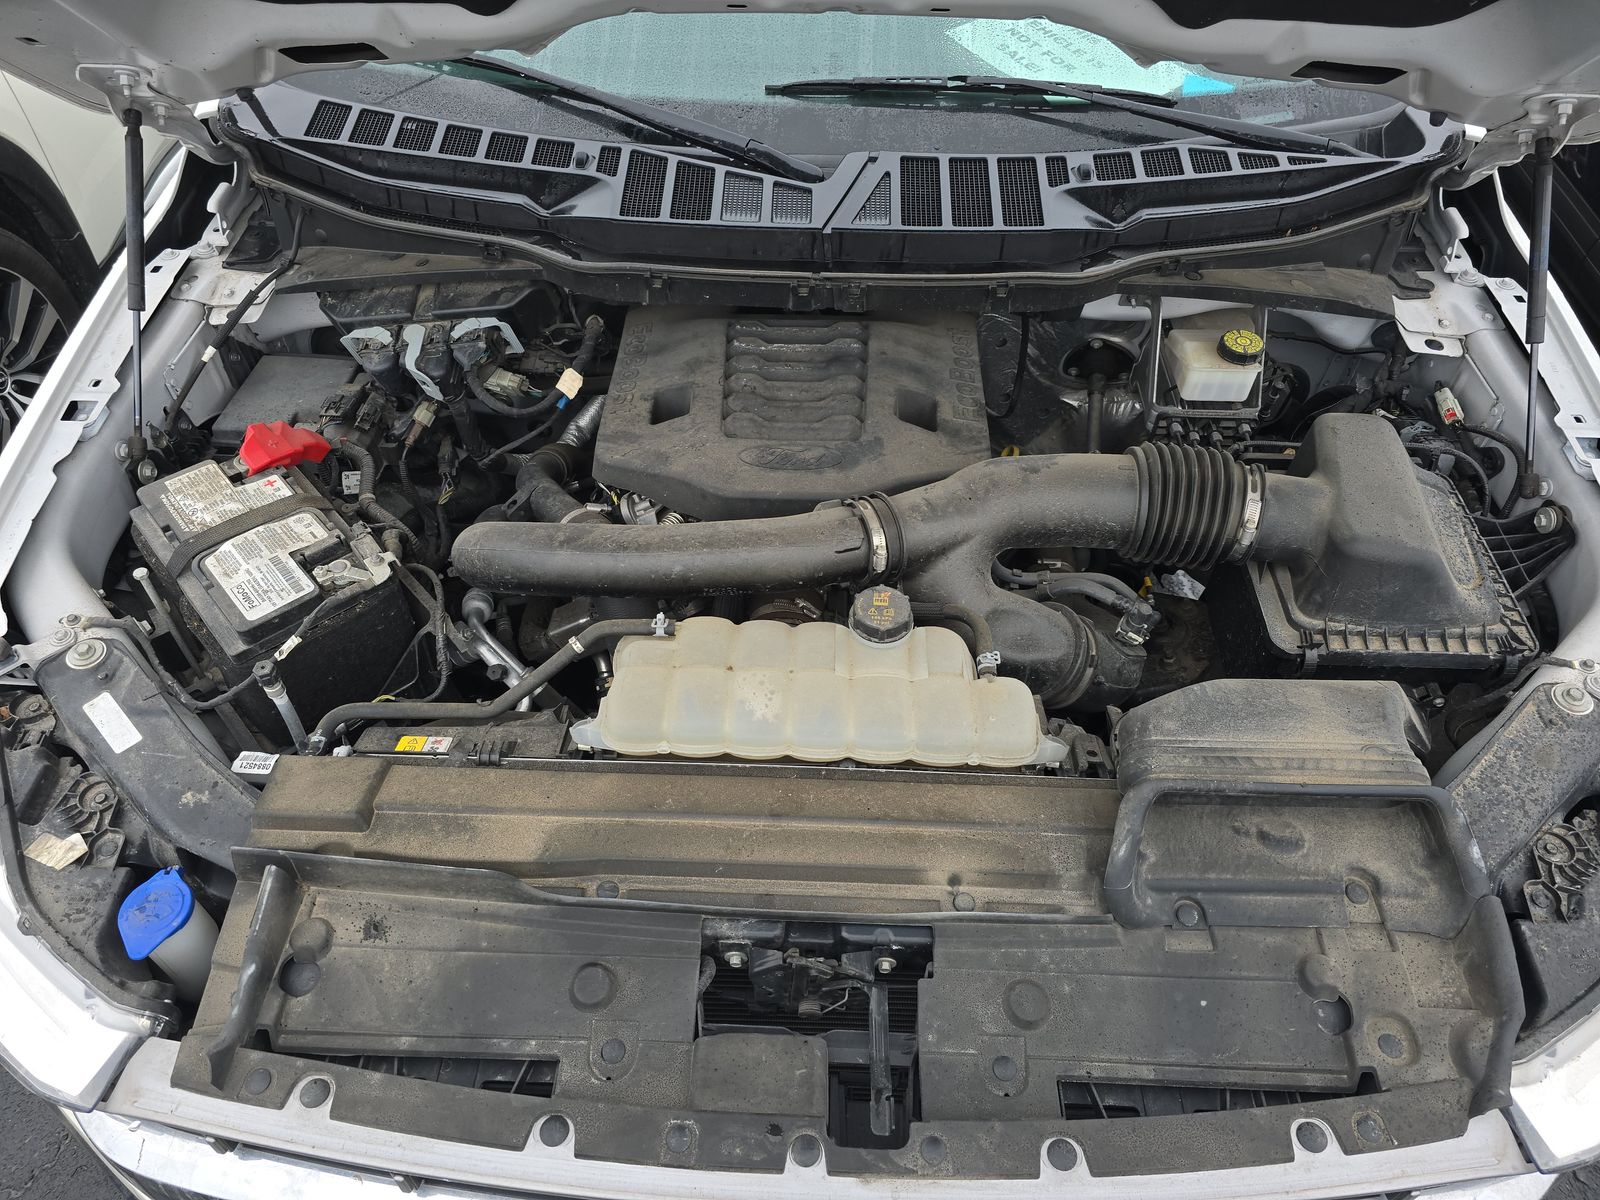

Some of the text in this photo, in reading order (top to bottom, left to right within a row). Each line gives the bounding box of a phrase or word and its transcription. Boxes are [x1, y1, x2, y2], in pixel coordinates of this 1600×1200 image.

[1004, 27, 1078, 73] NOT FOR
[1024, 20, 1088, 57] EHICLE
[236, 583, 259, 610] FoMoCo
